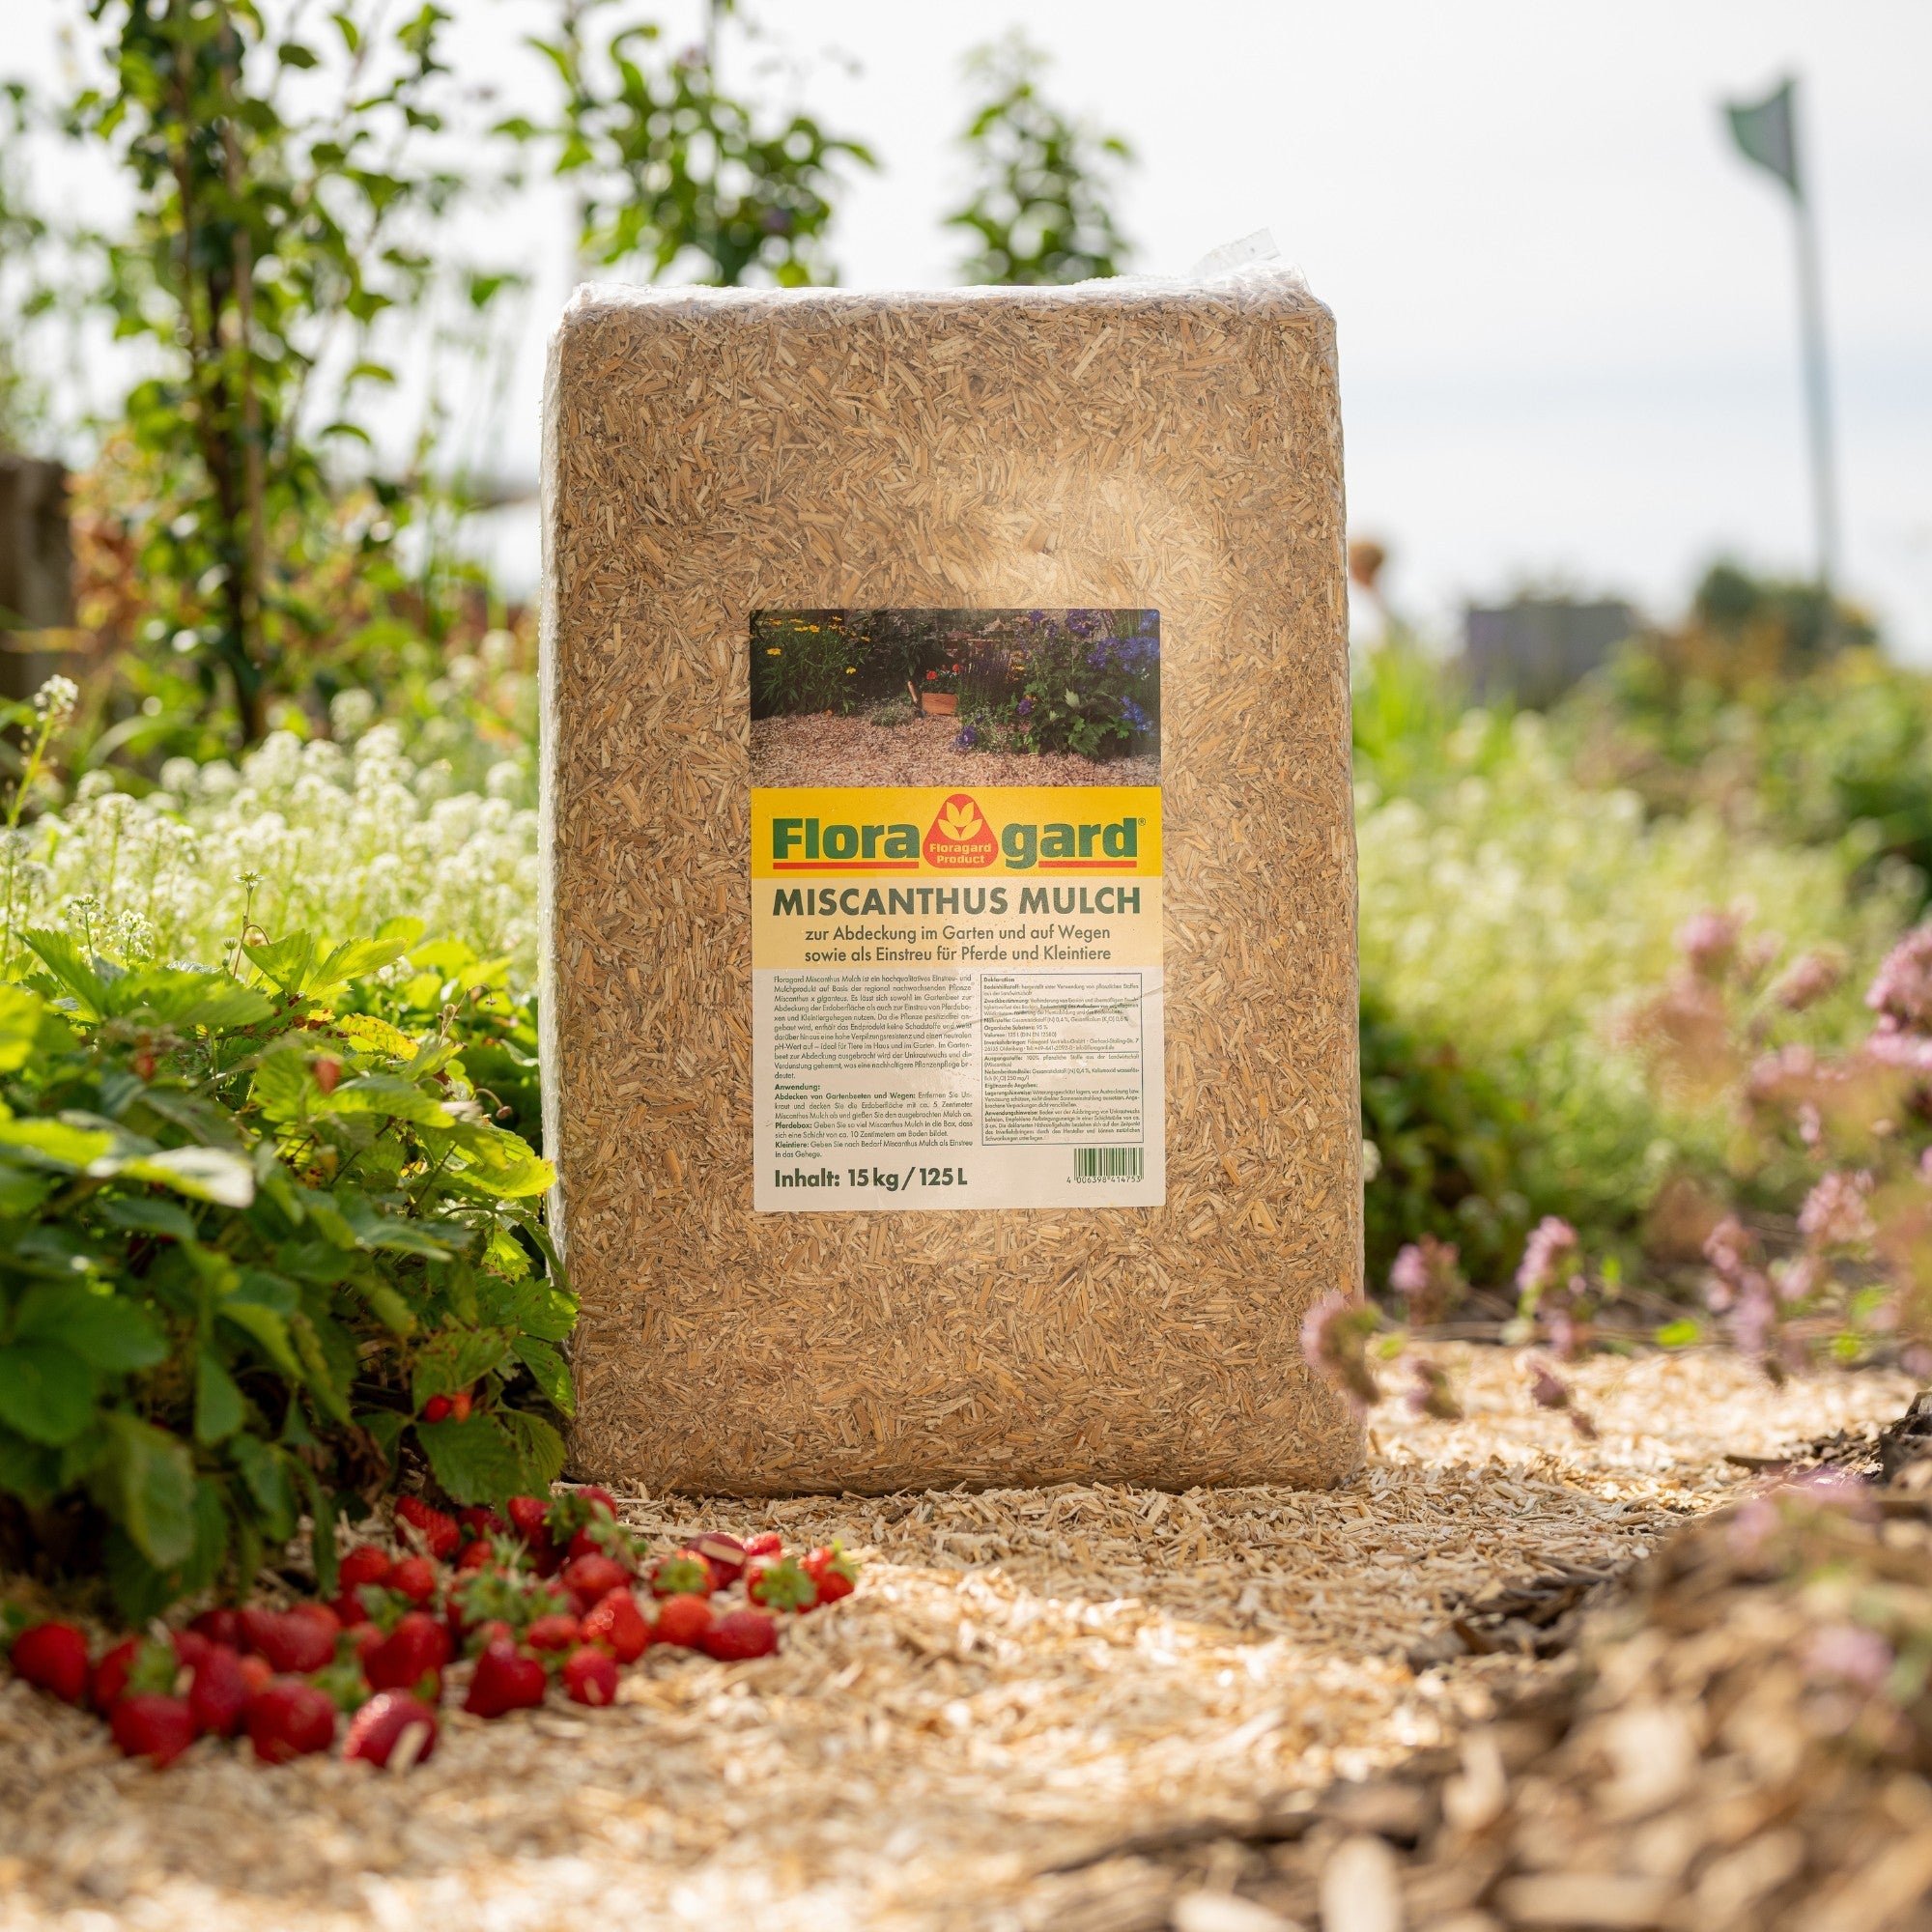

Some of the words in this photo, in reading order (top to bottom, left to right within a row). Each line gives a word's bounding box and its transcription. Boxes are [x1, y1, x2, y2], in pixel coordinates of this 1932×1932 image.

[773, 818, 920, 860] Flora
[929, 842, 991, 855] Floragard
[937, 855, 985, 865] Product
[773, 888, 1009, 916] MISCANTHUS
[1019, 887, 1140, 914] MULCH
[806, 929, 830, 940] zur
[833, 926, 916, 943] Abdeckung
[922, 926, 938, 939] im
[943, 925, 994, 940] Garten
[999, 925, 1026, 939] und
[1030, 924, 1055, 939] auf
[1058, 924, 1111, 942] Wegen
[805, 949, 846, 962] sowie
[850, 949, 871, 961] als
[877, 948, 932, 961] Einstreu
[937, 947, 957, 961] für
[961, 947, 1008, 960] Pferde
[1011, 947, 1038, 960] und
[1044, 946, 1111, 960] Kleintiere
[775, 1083, 821, 1093] Anwendung:
[776, 1168, 839, 1187] Inhalt:
